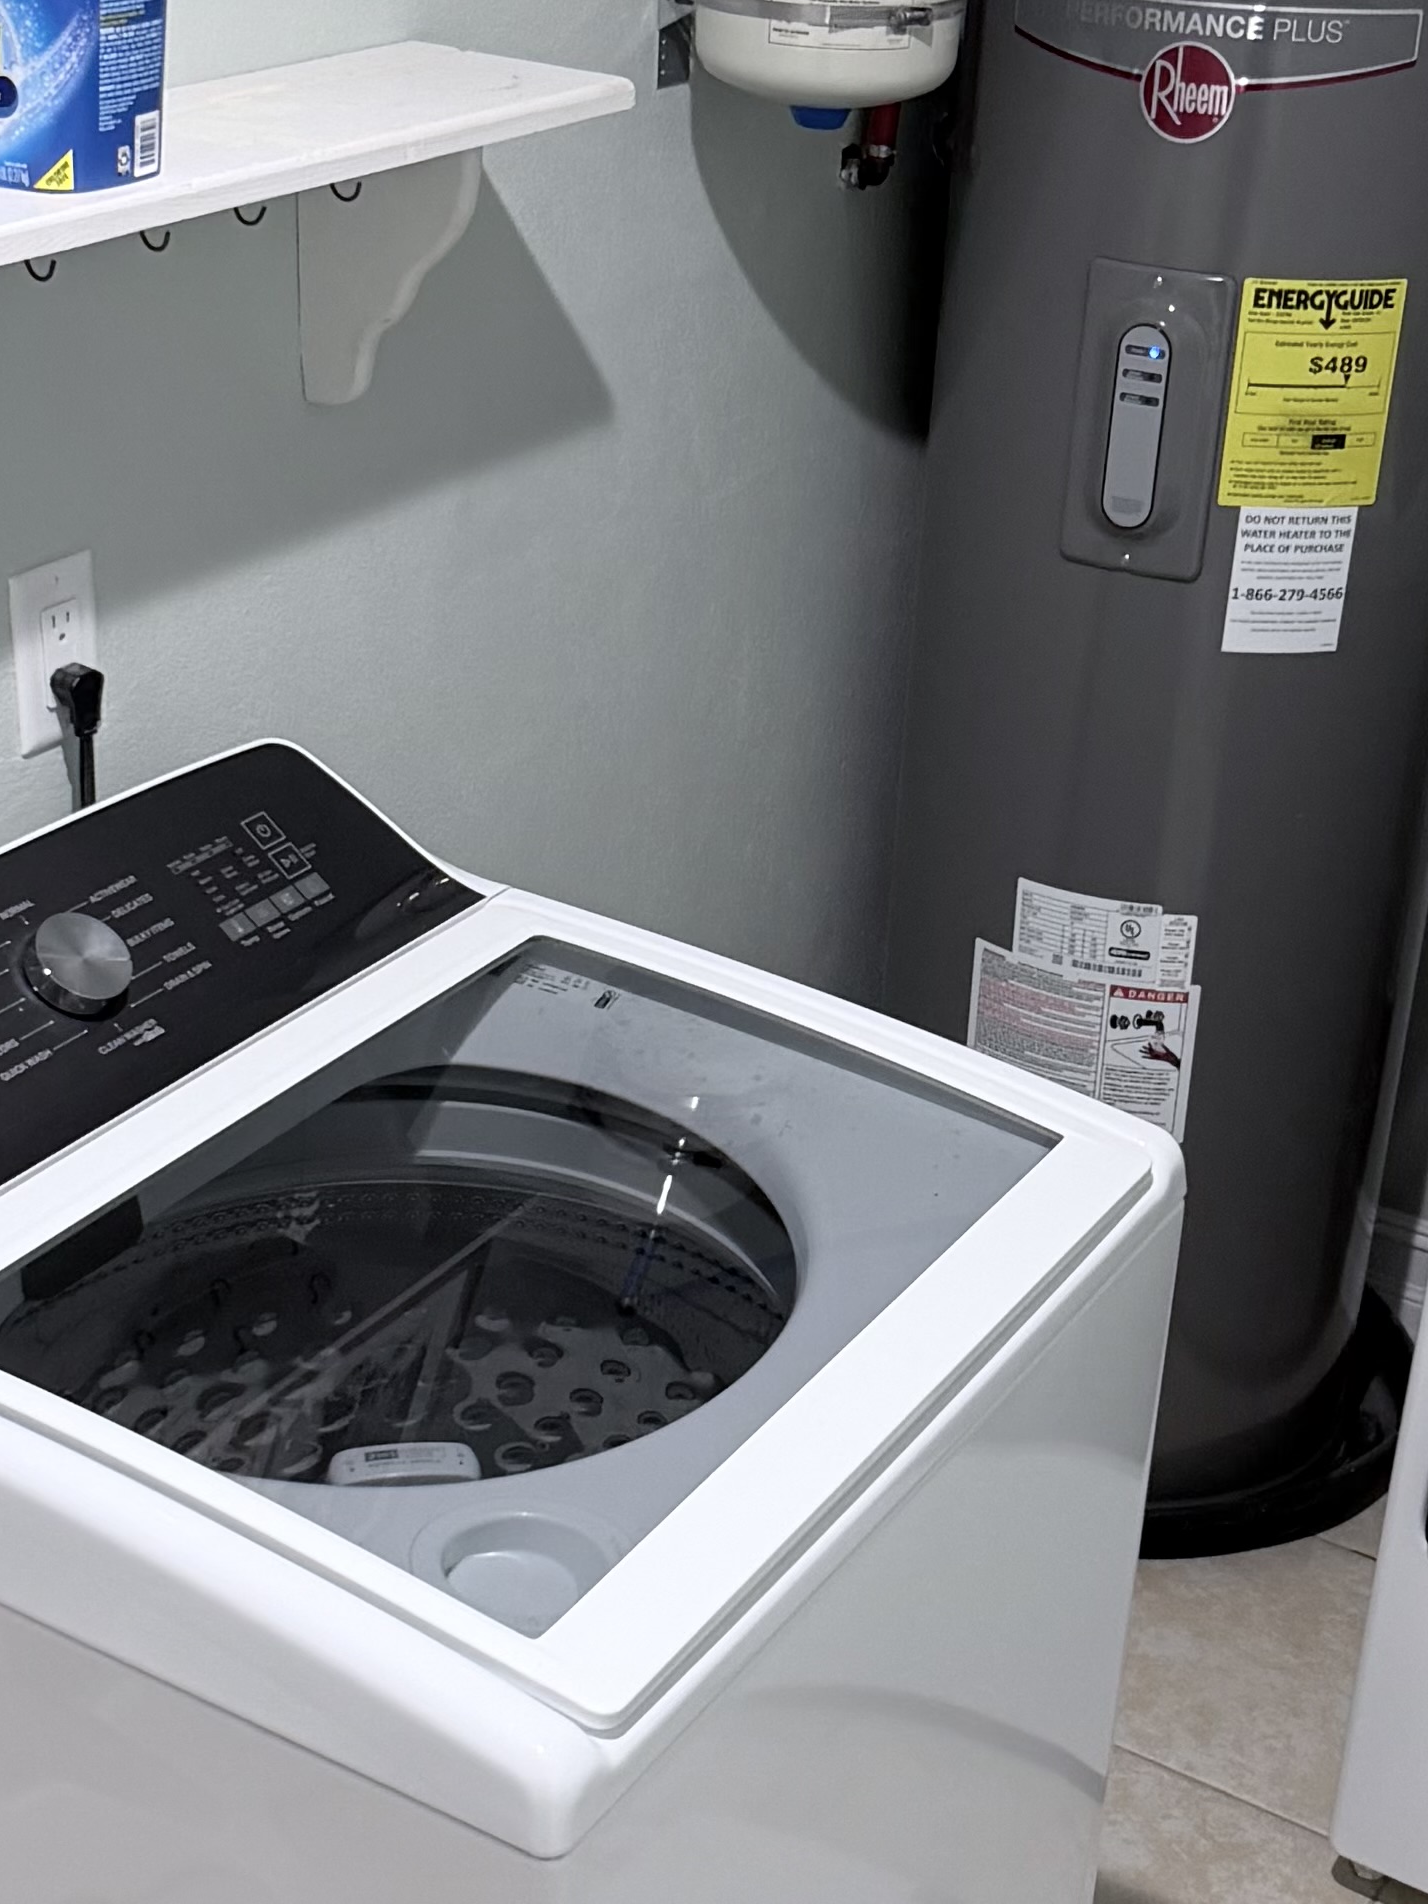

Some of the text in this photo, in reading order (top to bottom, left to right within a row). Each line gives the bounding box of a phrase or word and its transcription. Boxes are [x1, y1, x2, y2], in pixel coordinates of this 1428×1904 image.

[1273, 18, 1345, 43] PLUS
[1150, 46, 1229, 125] Rheem
[1252, 287, 1398, 314] ENERGYGUIDE
[1308, 355, 1369, 375] $489
[1245, 514, 1353, 526] DO NOT RETURN THIS
[1240, 529, 1352, 540] WATER HEATER TO THE
[1243, 543, 1345, 554] PLACE OF PURCHASE
[1231, 586, 1344, 602] 1-866-279-4566
[89, 874, 138, 904] ACTIVEWEAR
[111, 892, 154, 919] DELICATES
[1128, 987, 1185, 1003] DANGER
